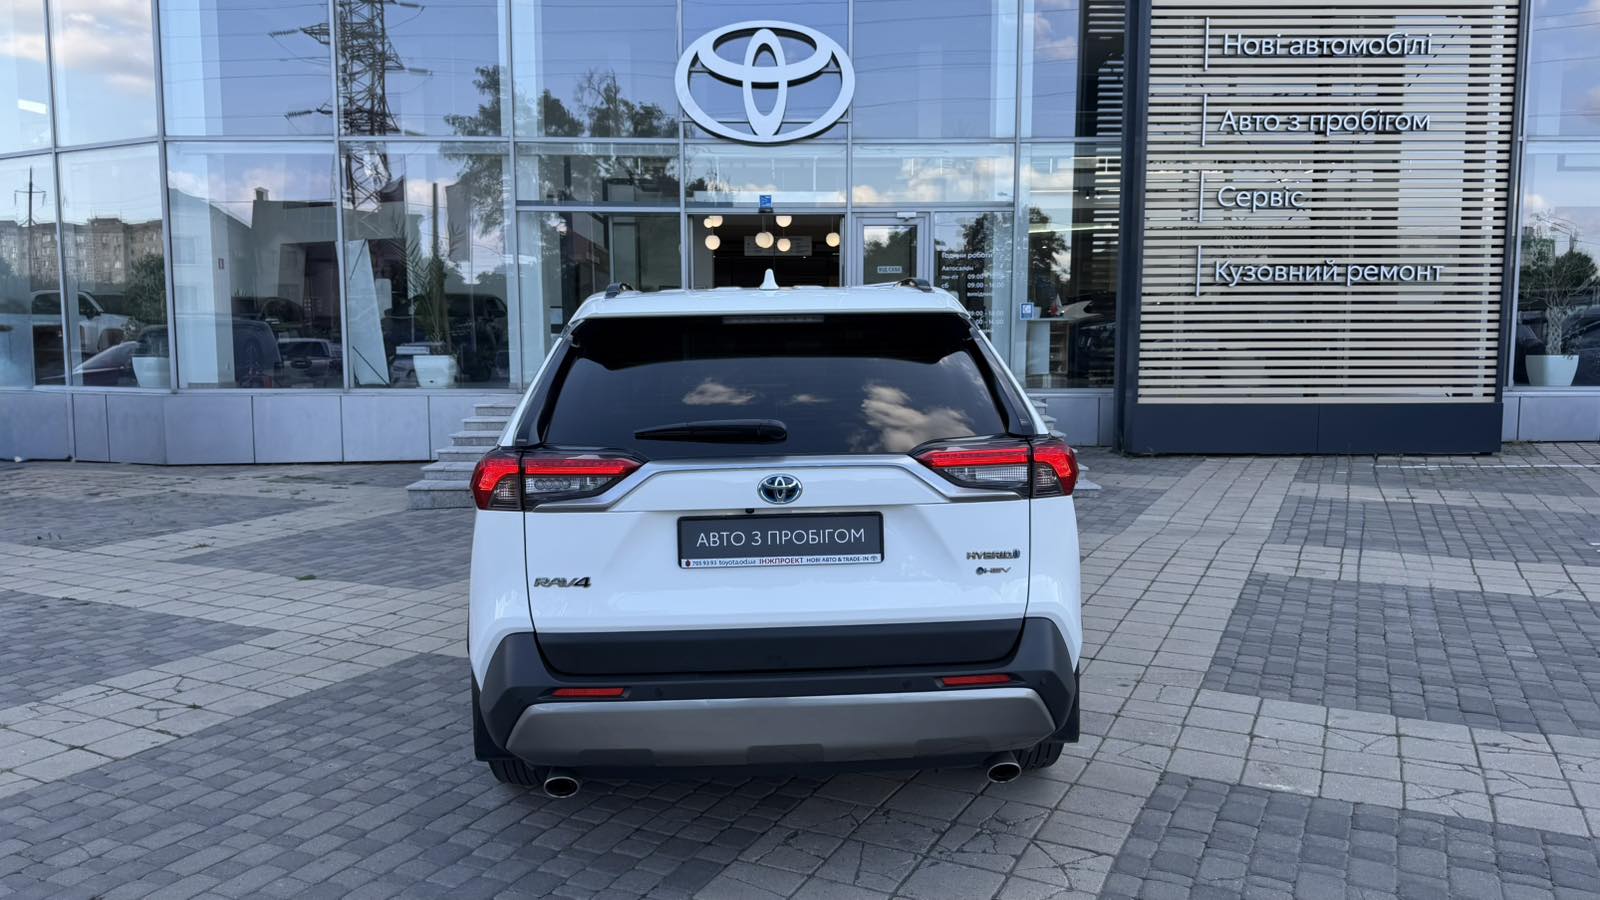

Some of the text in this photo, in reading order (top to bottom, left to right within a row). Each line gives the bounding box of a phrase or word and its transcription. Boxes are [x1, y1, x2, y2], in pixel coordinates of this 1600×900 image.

[1223, 32, 1433, 56] Нові автомобілі
[1219, 108, 1431, 137] Авто з пробігом
[1217, 186, 1306, 213] Сервіс
[1214, 259, 1445, 287] Кузовний ремонт
[696, 528, 865, 548] АВТО З ПРОБІГОМ
[966, 551, 1013, 560] HYBRID
[534, 577, 592, 588] RAV4
